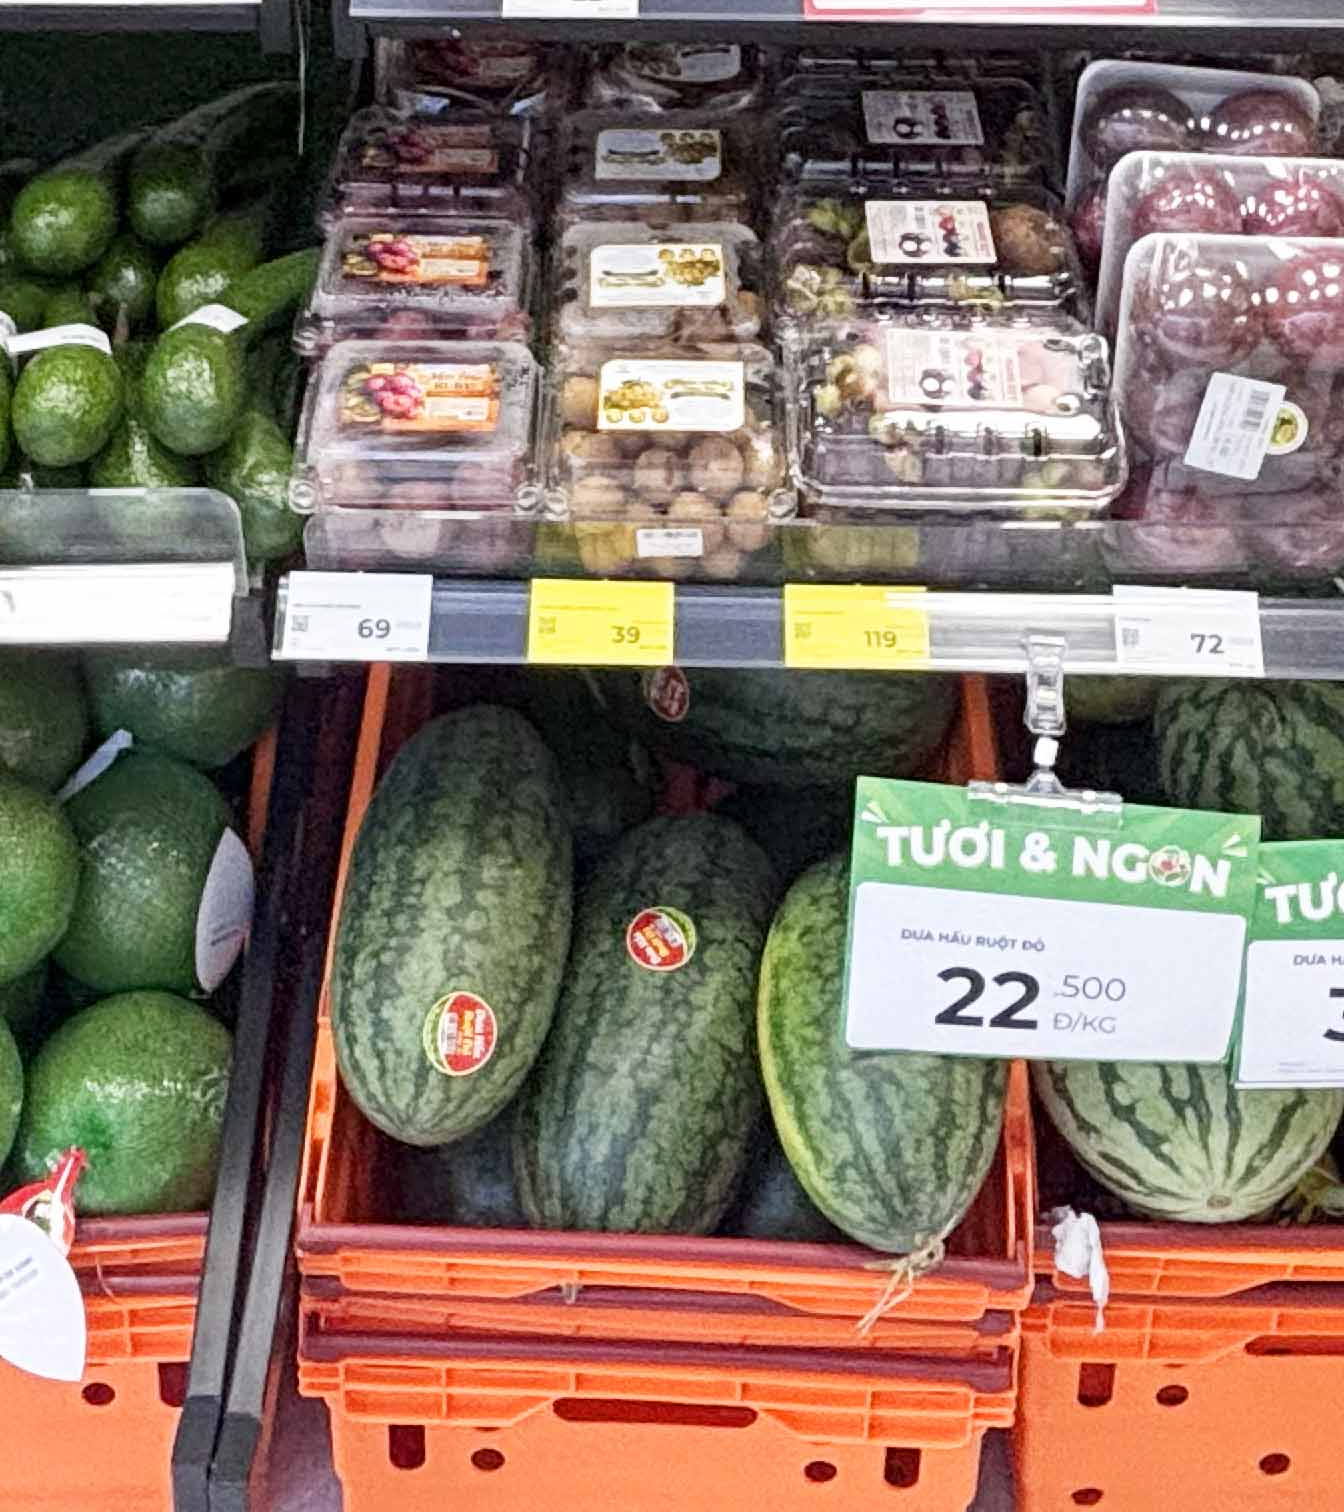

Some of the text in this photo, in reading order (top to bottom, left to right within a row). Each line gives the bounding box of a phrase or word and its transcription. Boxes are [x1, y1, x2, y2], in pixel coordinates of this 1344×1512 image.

[357, 618, 391, 639] 69
[612, 625, 641, 644] 39
[863, 630, 897, 649] 119
[1190, 633, 1225, 655] 72
[876, 818, 1232, 899] TƯƠI & NGON
[934, 965, 1041, 1031] 22
